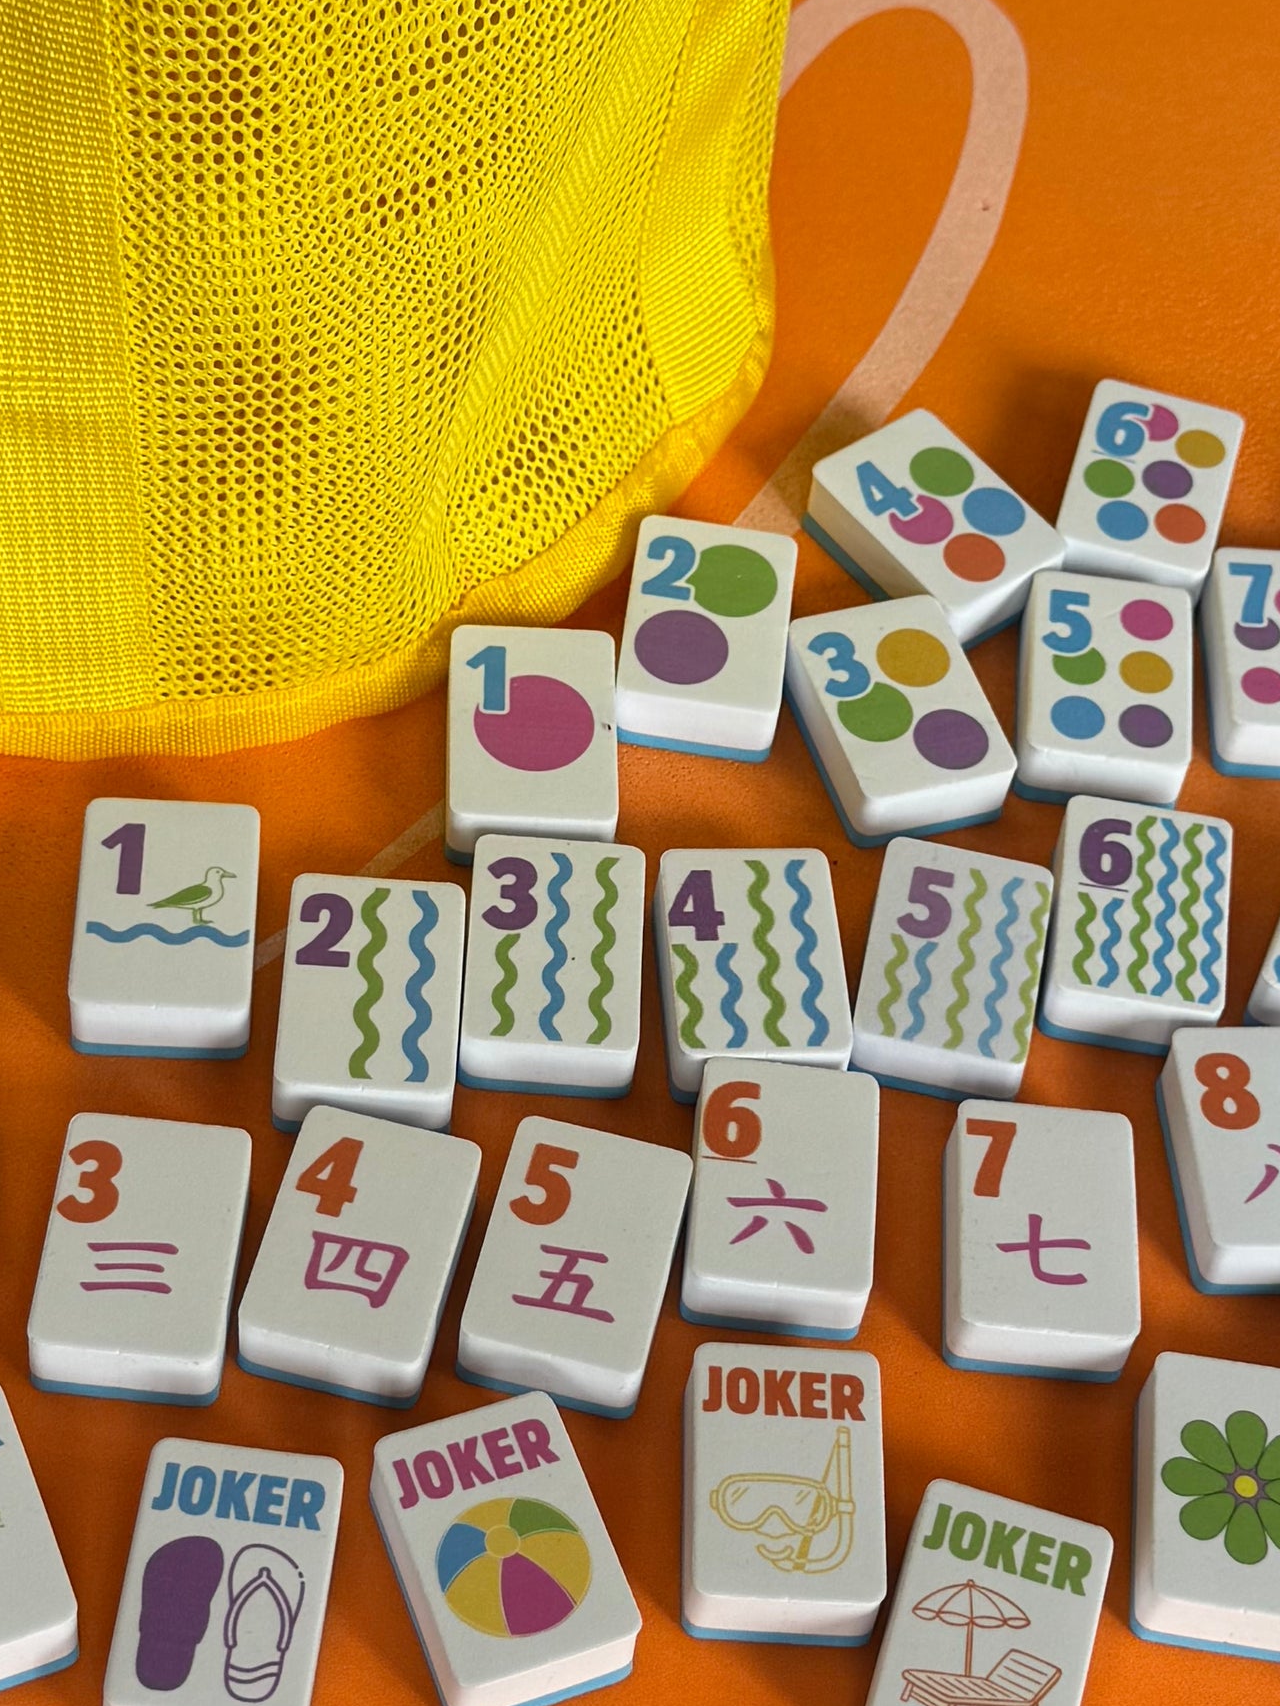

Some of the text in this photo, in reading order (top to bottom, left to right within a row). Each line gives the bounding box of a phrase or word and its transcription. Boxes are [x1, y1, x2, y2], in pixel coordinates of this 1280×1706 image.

[1096, 402, 1149, 456] 6
[857, 461, 916, 519] 4
[642, 537, 696, 601] 2
[1228, 563, 1274, 624] 7
[1043, 591, 1092, 652] 5
[465, 647, 507, 711] 1
[807, 632, 871, 696] 3
[101, 823, 147, 896] 1
[1079, 819, 1133, 886] 6
[295, 893, 353, 967] 2
[481, 857, 538, 931] 3
[668, 870, 724, 942] 4
[897, 869, 955, 939] 5
[704, 1082, 762, 1158] 6
[1195, 1053, 1261, 1130] 8
[57, 1140, 122, 1223] 3
[295, 1137, 365, 1217] 4
[509, 1144, 580, 1225] 5
[966, 1119, 1017, 1198] 7
[726, 1178, 828, 1254] 六
[996, 1214, 1091, 1286] 七
[80, 1242, 179, 1294] 三
[303, 1231, 410, 1308] 四
[512, 1244, 615, 1324] 五
[702, 1365, 866, 1422] JOKER
[151, 1462, 326, 1531] JOKER
[398, 1418, 559, 1509] JOKER
[922, 1502, 1093, 1596] JOKER
